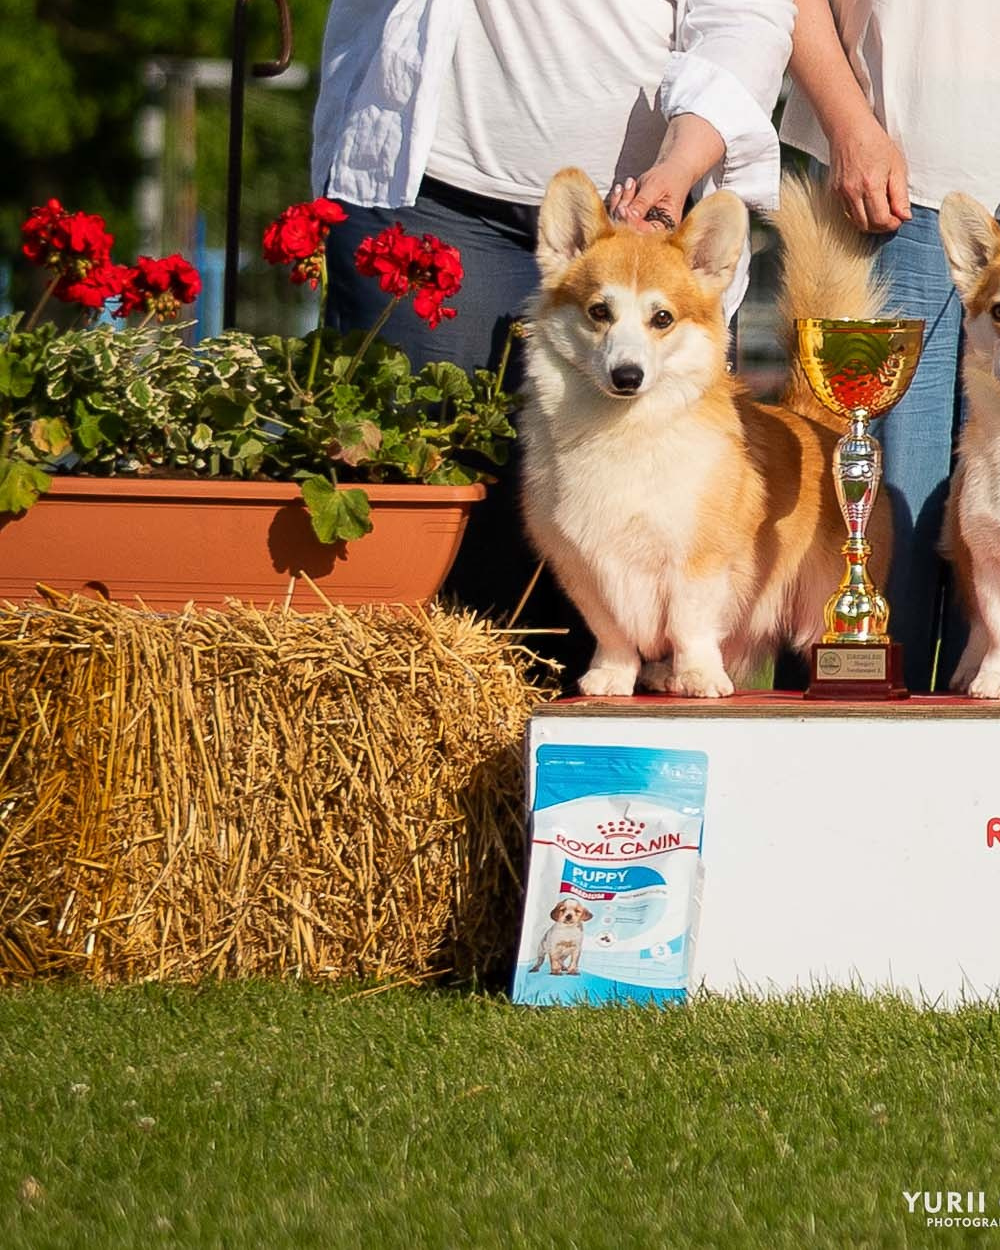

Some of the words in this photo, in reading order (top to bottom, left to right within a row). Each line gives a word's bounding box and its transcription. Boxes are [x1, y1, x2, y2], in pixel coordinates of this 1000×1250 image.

[556, 834, 614, 855] ROYAL
[620, 833, 680, 855] CANIN
[572, 867, 629, 883] PUPPY
